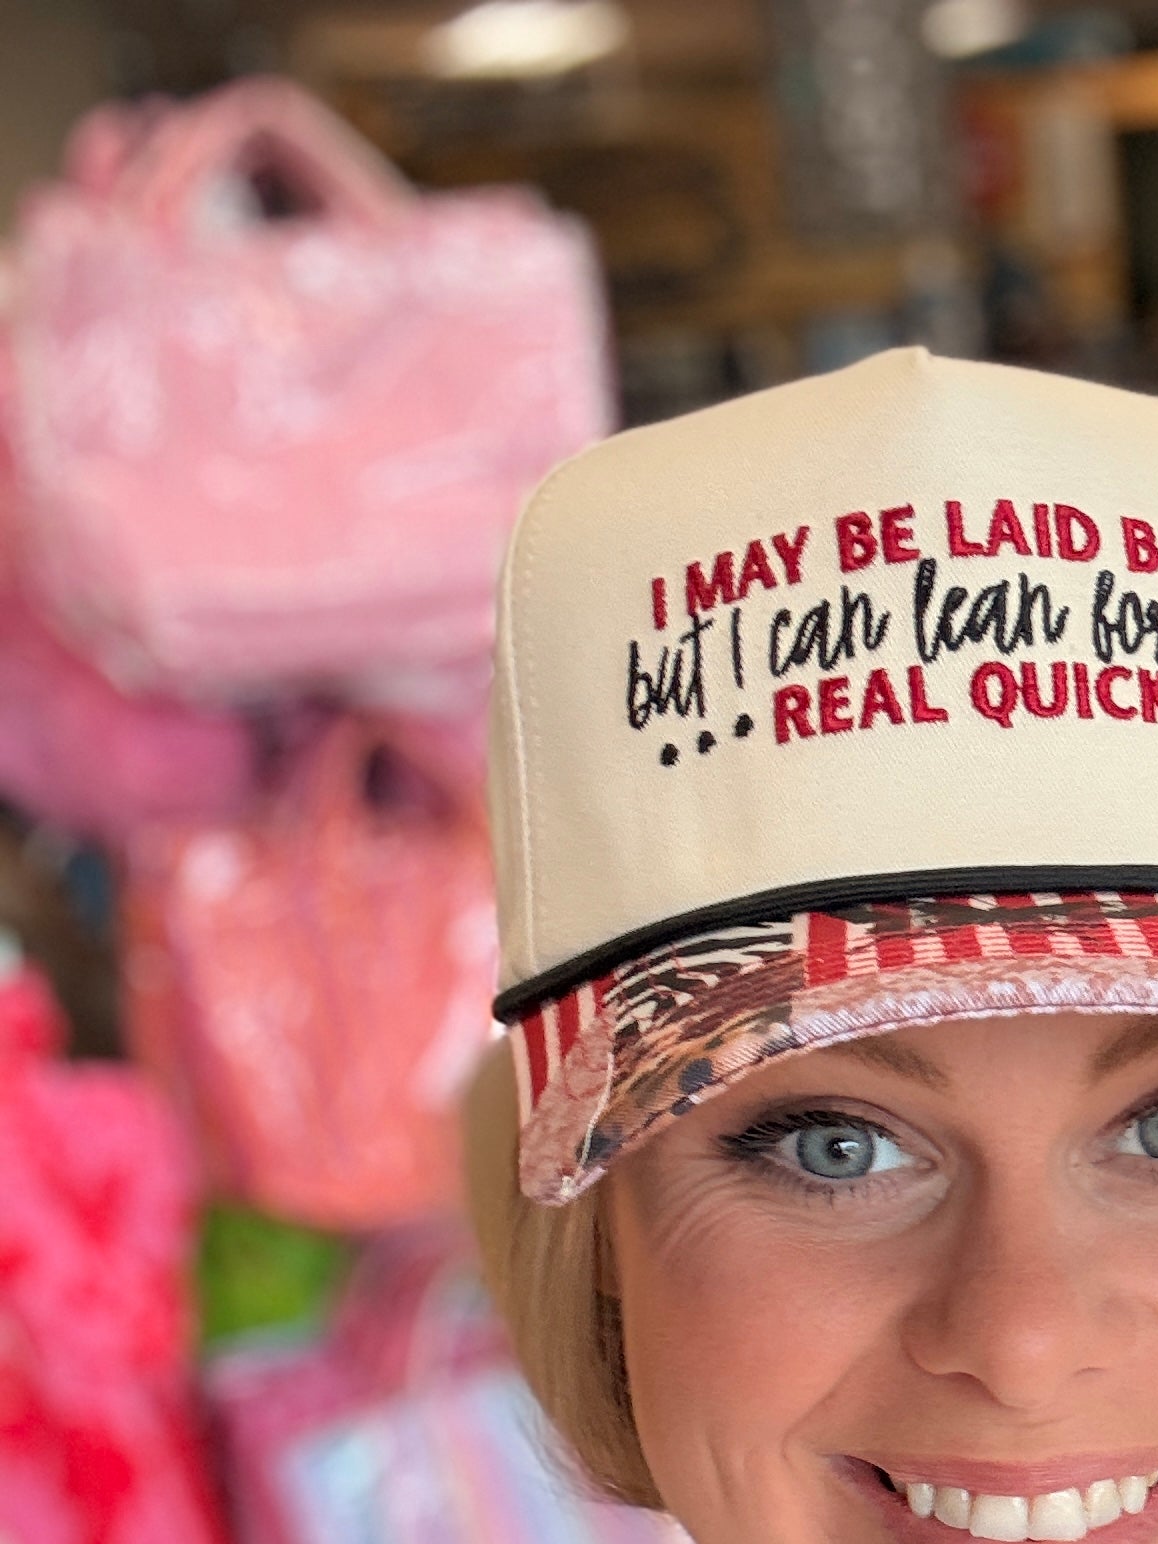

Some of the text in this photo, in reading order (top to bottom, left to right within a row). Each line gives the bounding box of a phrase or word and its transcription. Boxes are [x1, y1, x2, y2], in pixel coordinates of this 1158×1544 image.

[651, 576, 668, 631] I
[684, 525, 811, 617] MAY
[835, 503, 921, 574] BE
[944, 498, 1102, 560] LAID
[626, 614, 713, 730] but
[730, 606, 745, 689] I
[769, 584, 891, 678] can
[913, 557, 1070, 664] lean
[772, 664, 950, 746] REAL
